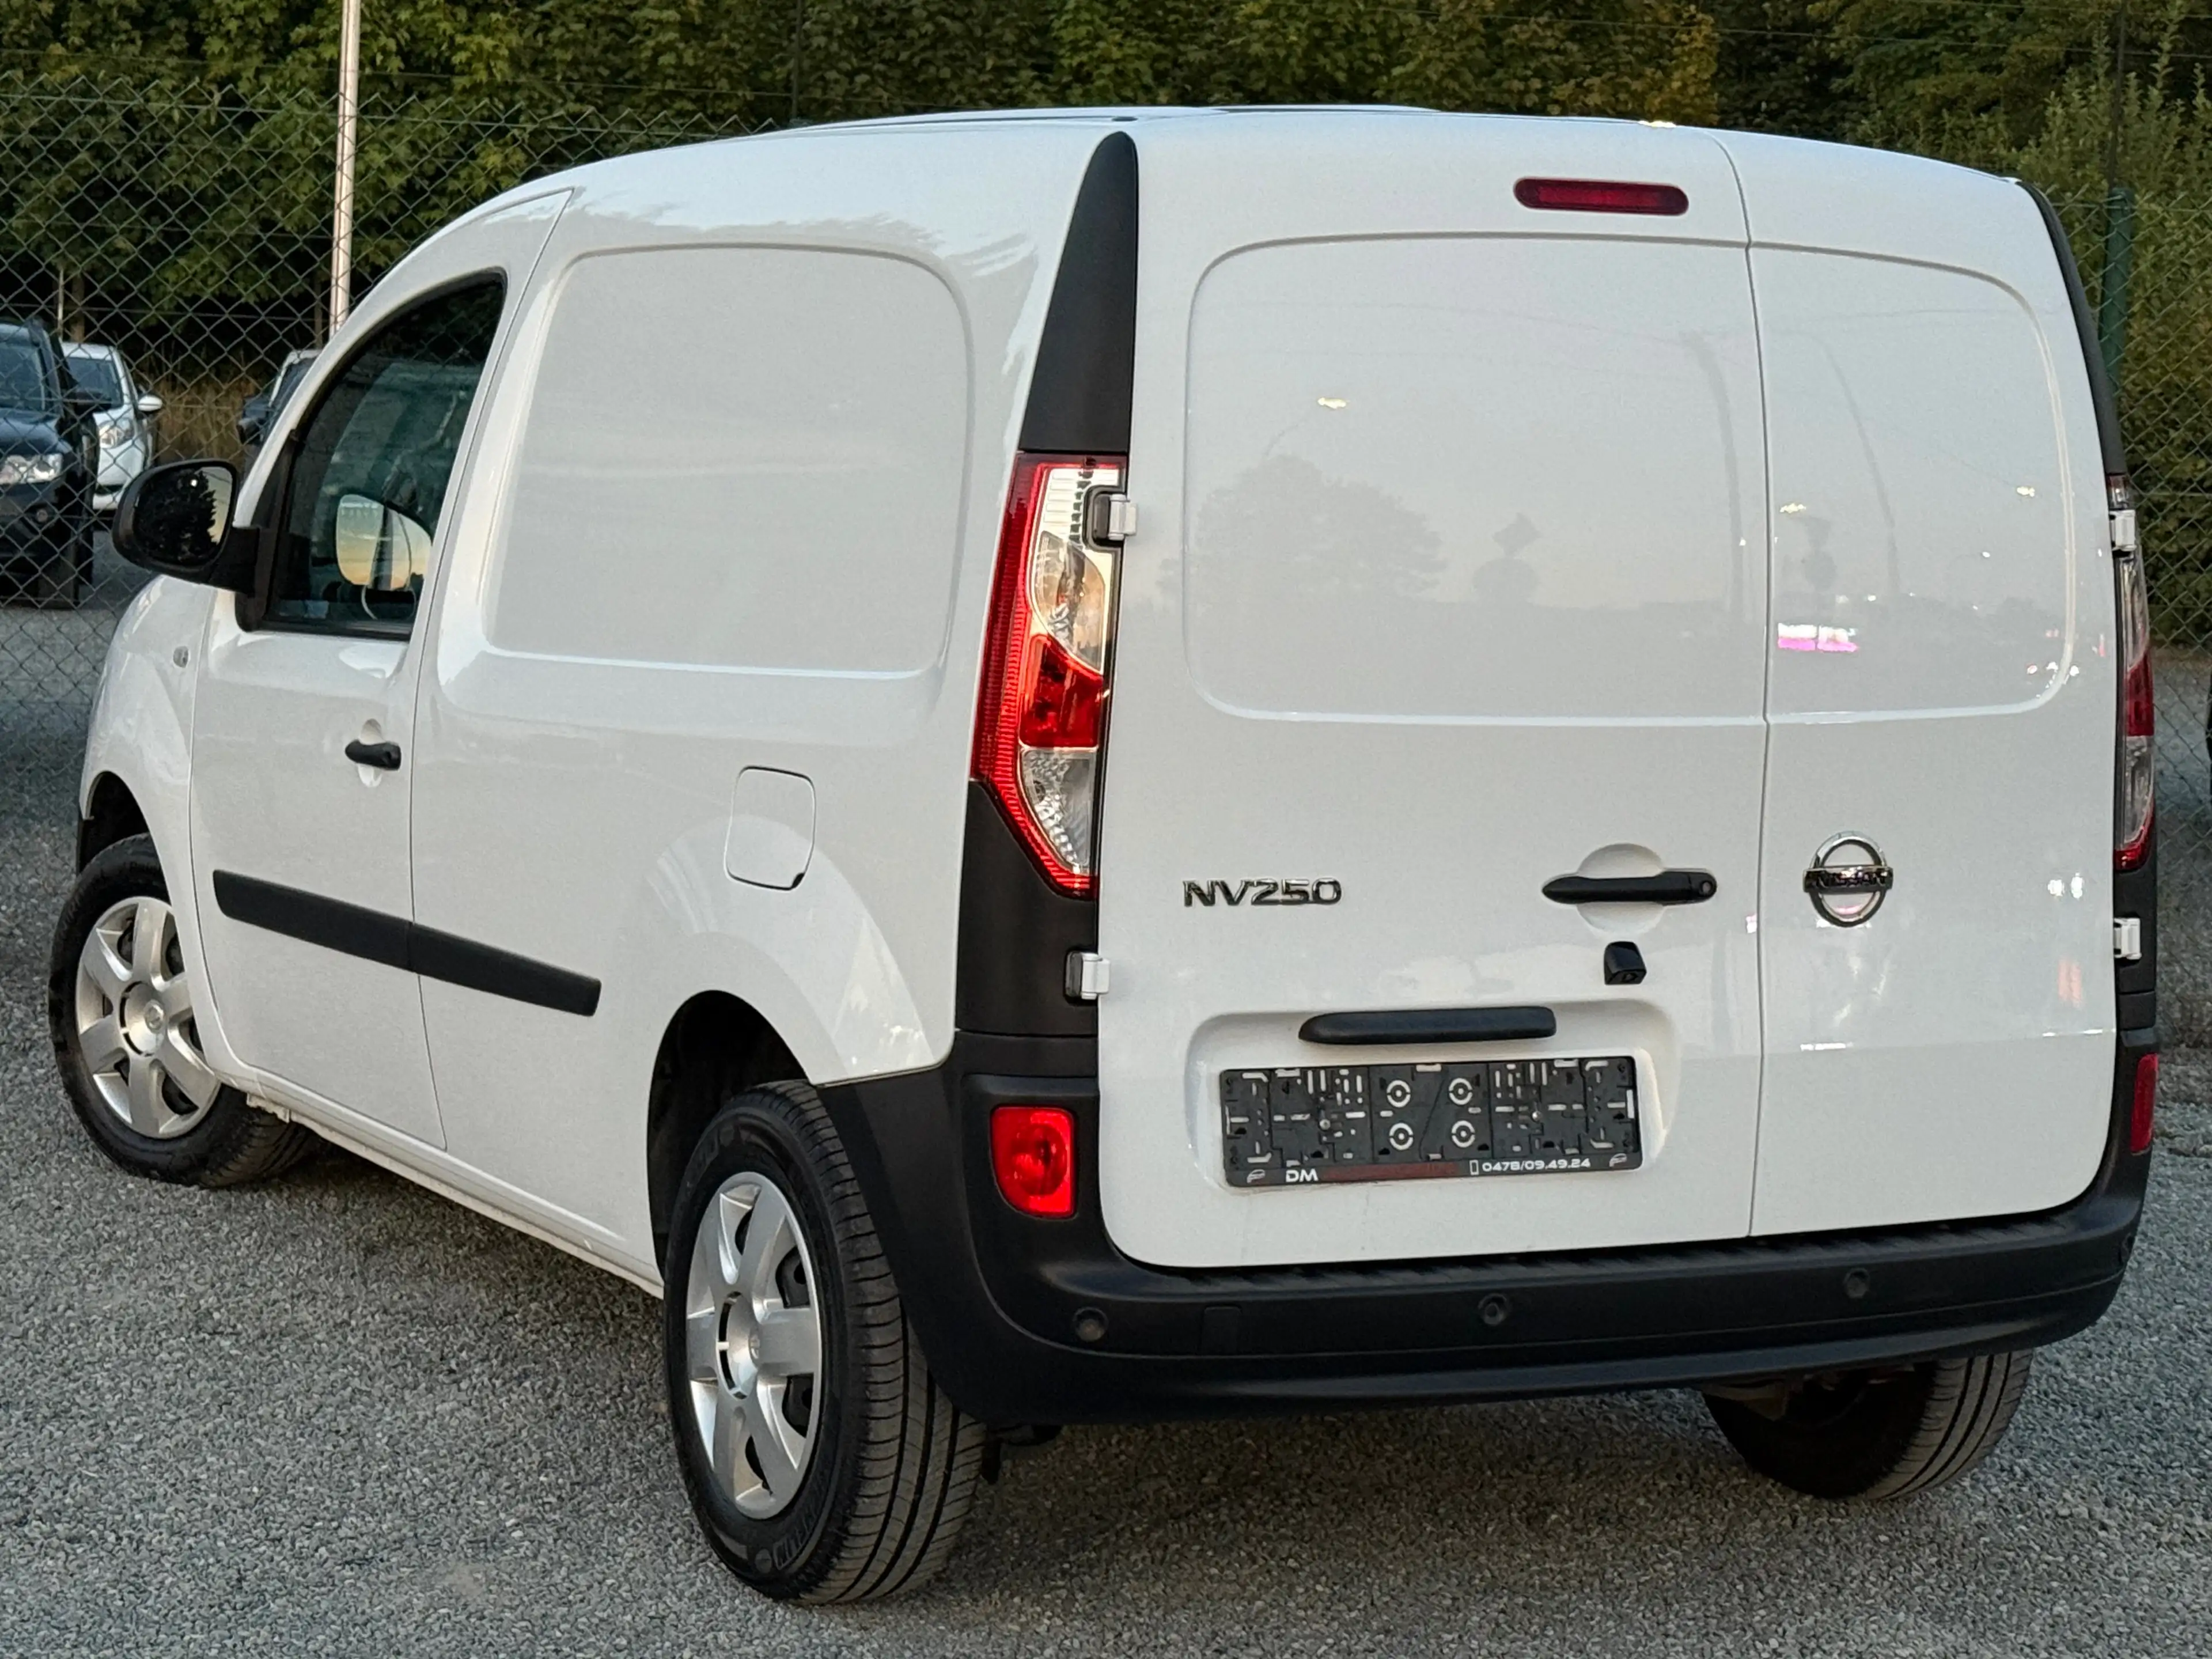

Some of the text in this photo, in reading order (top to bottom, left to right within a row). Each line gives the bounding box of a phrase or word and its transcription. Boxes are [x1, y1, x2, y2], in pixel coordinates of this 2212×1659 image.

[1183, 877, 1342, 907] NV250
[1482, 1158, 1591, 1172] 0478/09.49.24
[1286, 1169, 1319, 1183] DM
